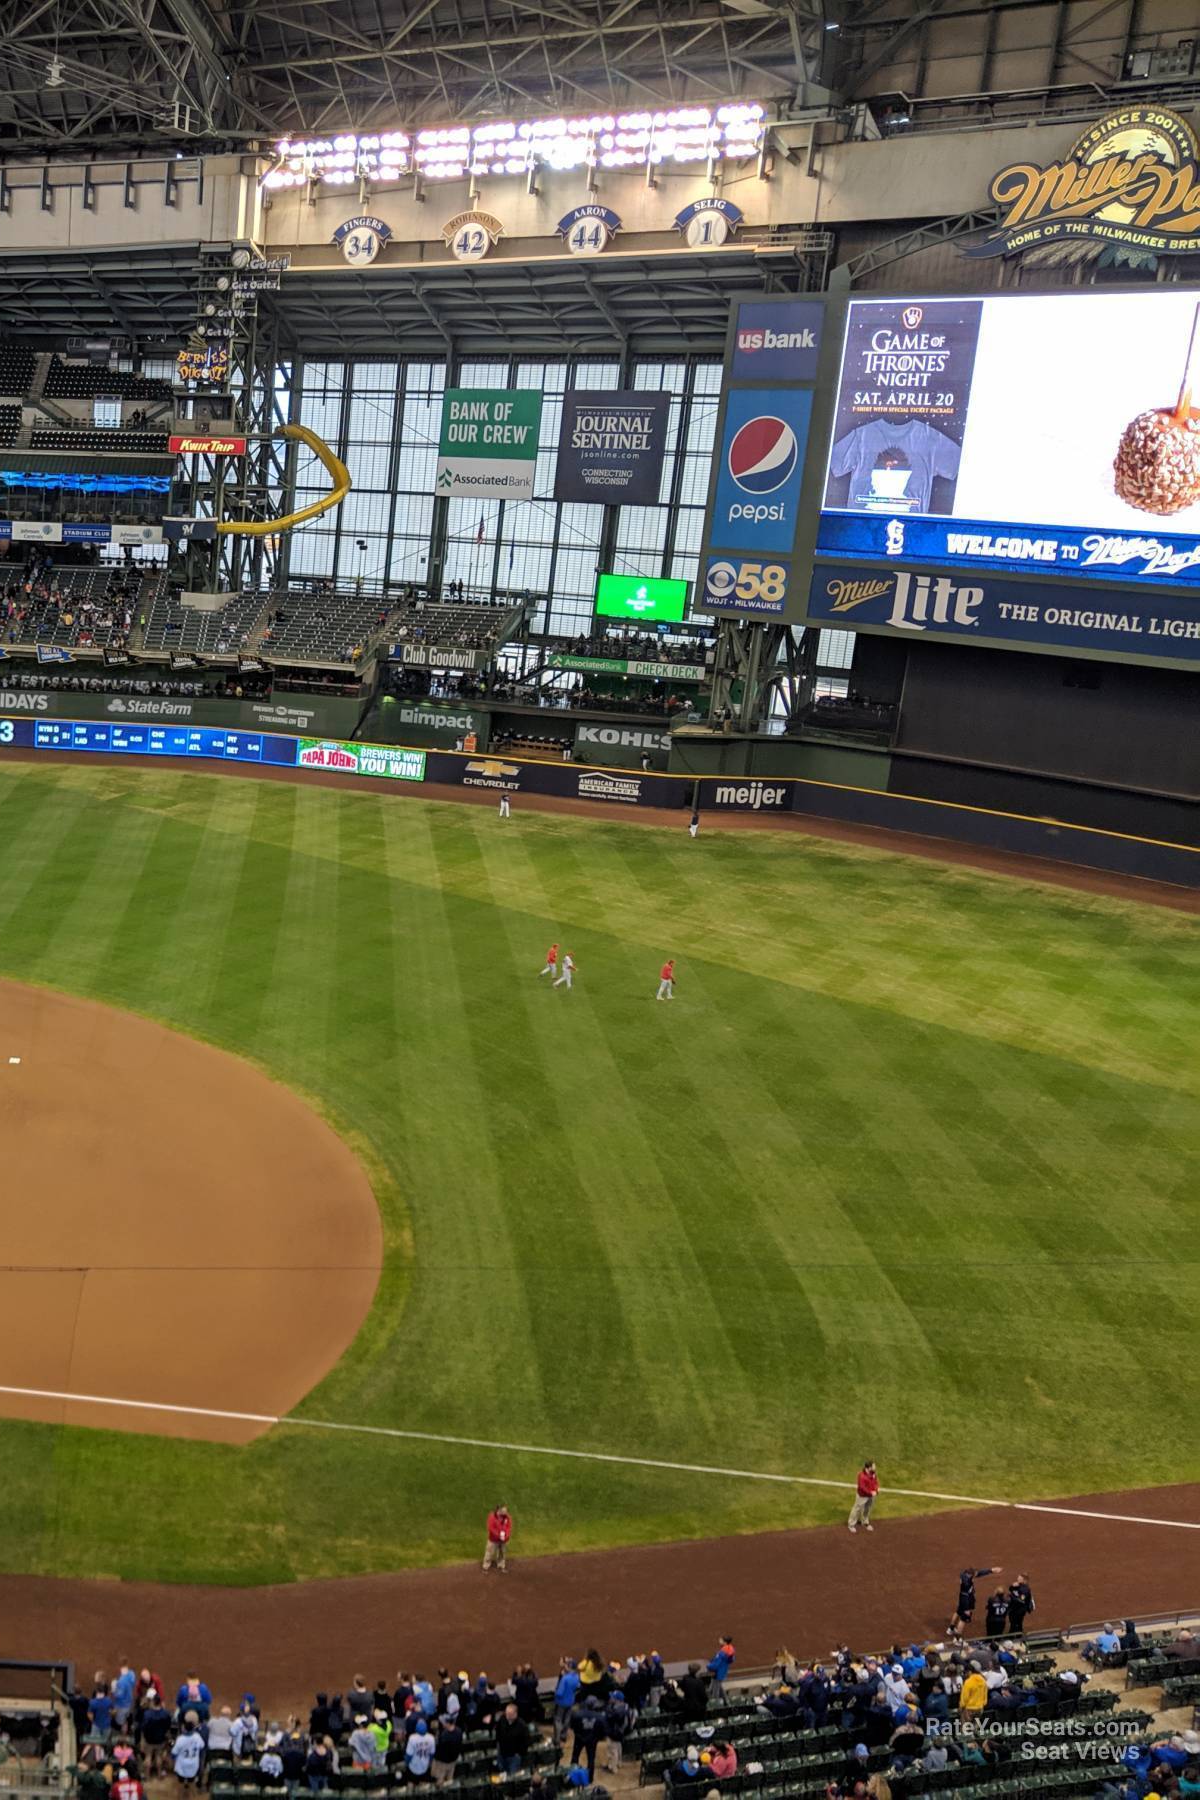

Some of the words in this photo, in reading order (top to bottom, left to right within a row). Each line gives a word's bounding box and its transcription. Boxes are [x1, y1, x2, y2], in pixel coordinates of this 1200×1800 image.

[1090, 111, 1141, 141] SINCE
[1145, 112, 1179, 134] 2001
[991, 154, 1158, 230] Miller
[573, 206, 607, 220] AARON
[693, 199, 727, 212] SELIG
[343, 218, 383, 232] FINGERS
[450, 214, 496, 229] ROBINSON
[456, 231, 485, 254] 42
[572, 224, 602, 250] 44
[701, 220, 713, 245] 1
[1007, 229, 1042, 250] HOME
[1044, 224, 1061, 236] OF
[1065, 223, 1090, 234] THE
[1093, 225, 1166, 249] MILWAUKEE
[348, 235, 373, 258] 34
[217, 309, 232, 317] Get
[871, 330, 930, 352] GAME
[930, 336, 946, 348] OF
[862, 351, 949, 373] THRONES
[877, 373, 931, 387] NIGHT
[853, 391, 882, 406] SAT,
[886, 393, 932, 406] APRIL
[935, 393, 954, 406] 20
[450, 401, 489, 421] BANK
[494, 402, 514, 421] OF
[572, 415, 653, 433] JOURNAL
[448, 424, 478, 443] OUR
[483, 425, 528, 445] CREW
[571, 433, 651, 450] SENTINEL
[581, 450, 639, 460] jsonline.com
[581, 468, 633, 477] CONNECTING
[584, 476, 629, 486] WISCONSIN
[728, 502, 785, 524] pepsi
[947, 533, 1058, 561] WELCOME
[1061, 545, 1079, 560] TO
[735, 563, 787, 602] 58
[706, 596, 728, 606] WDJT
[735, 599, 782, 611] MILWAUKEE
[827, 579, 895, 612] Miller
[885, 571, 984, 631] Lite
[999, 603, 1040, 622] THE
[1044, 607, 1143, 633] ORIGINAL
[403, 644, 426, 665] Club
[429, 647, 475, 668] Goodwill
[635, 663, 669, 677] CHECK
[672, 666, 699, 678] DECK
[413, 708, 473, 730] impact
[578, 726, 672, 751] KOHL'S
[302, 750, 326, 764] PAPA
[360, 747, 401, 760] BREWERS
[403, 751, 423, 764] WIN!
[360, 759, 386, 773] YOU
[390, 761, 421, 777] WIN!
[463, 777, 520, 790] CHEVROLET
[580, 778, 614, 787] AMERICAN
[615, 780, 640, 790] FAMILY
[716, 782, 786, 809] meijer
